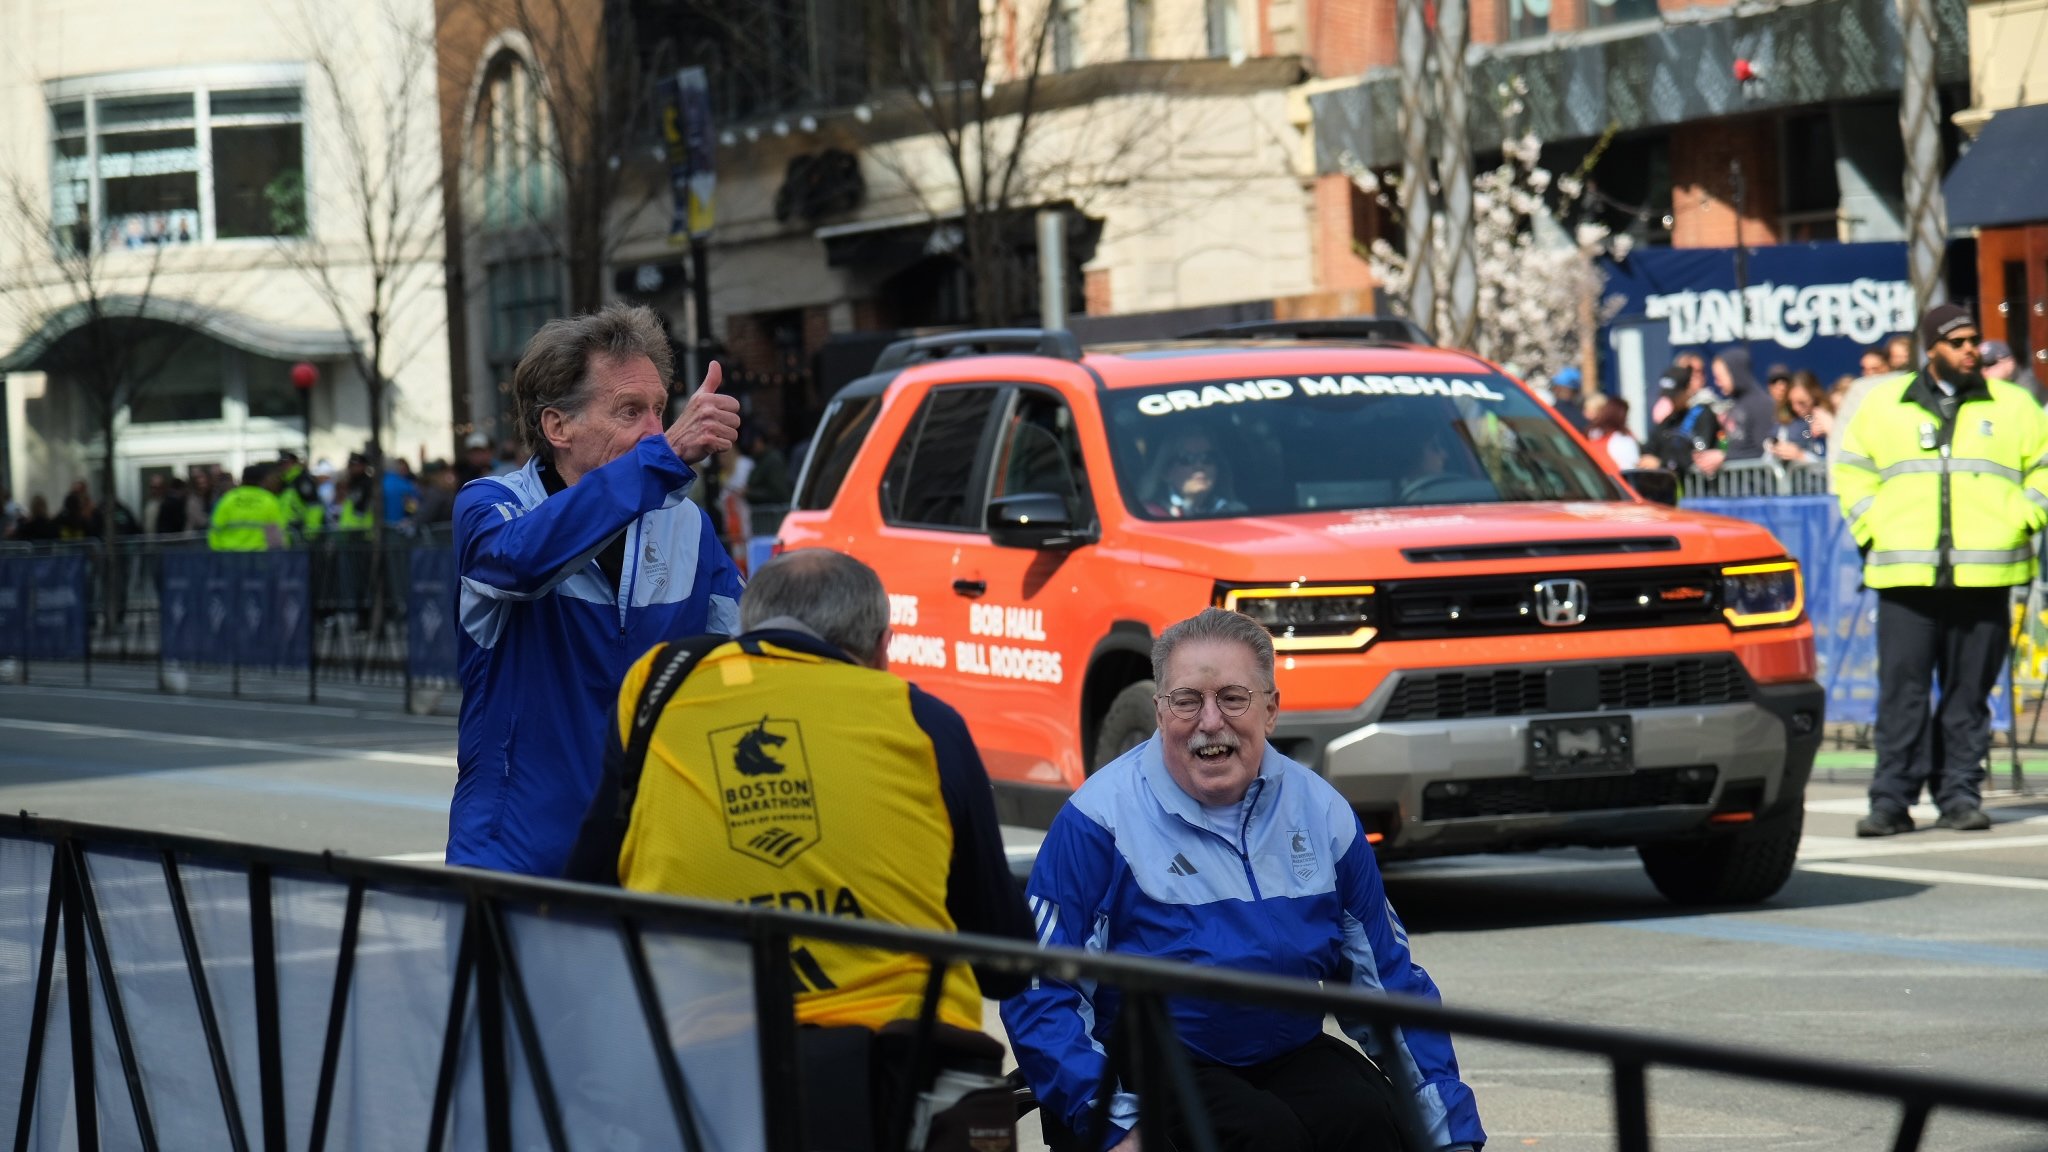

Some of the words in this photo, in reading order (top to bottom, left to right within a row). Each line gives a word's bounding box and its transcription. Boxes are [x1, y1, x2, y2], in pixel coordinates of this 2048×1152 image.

[1138, 378, 1294, 416] GRAND
[1298, 375, 1504, 401] MARSHAL
[888, 594, 918, 627] 975
[970, 603, 1004, 637] BOB
[1005, 606, 1047, 642] HALL
[886, 632, 947, 669] AMPIONS
[954, 640, 990, 676] BILL
[989, 644, 1063, 685] RODGERS
[637, 650, 691, 727] Canon
[725, 780, 808, 803] BOSTON
[728, 798, 812, 815] MARATHON
